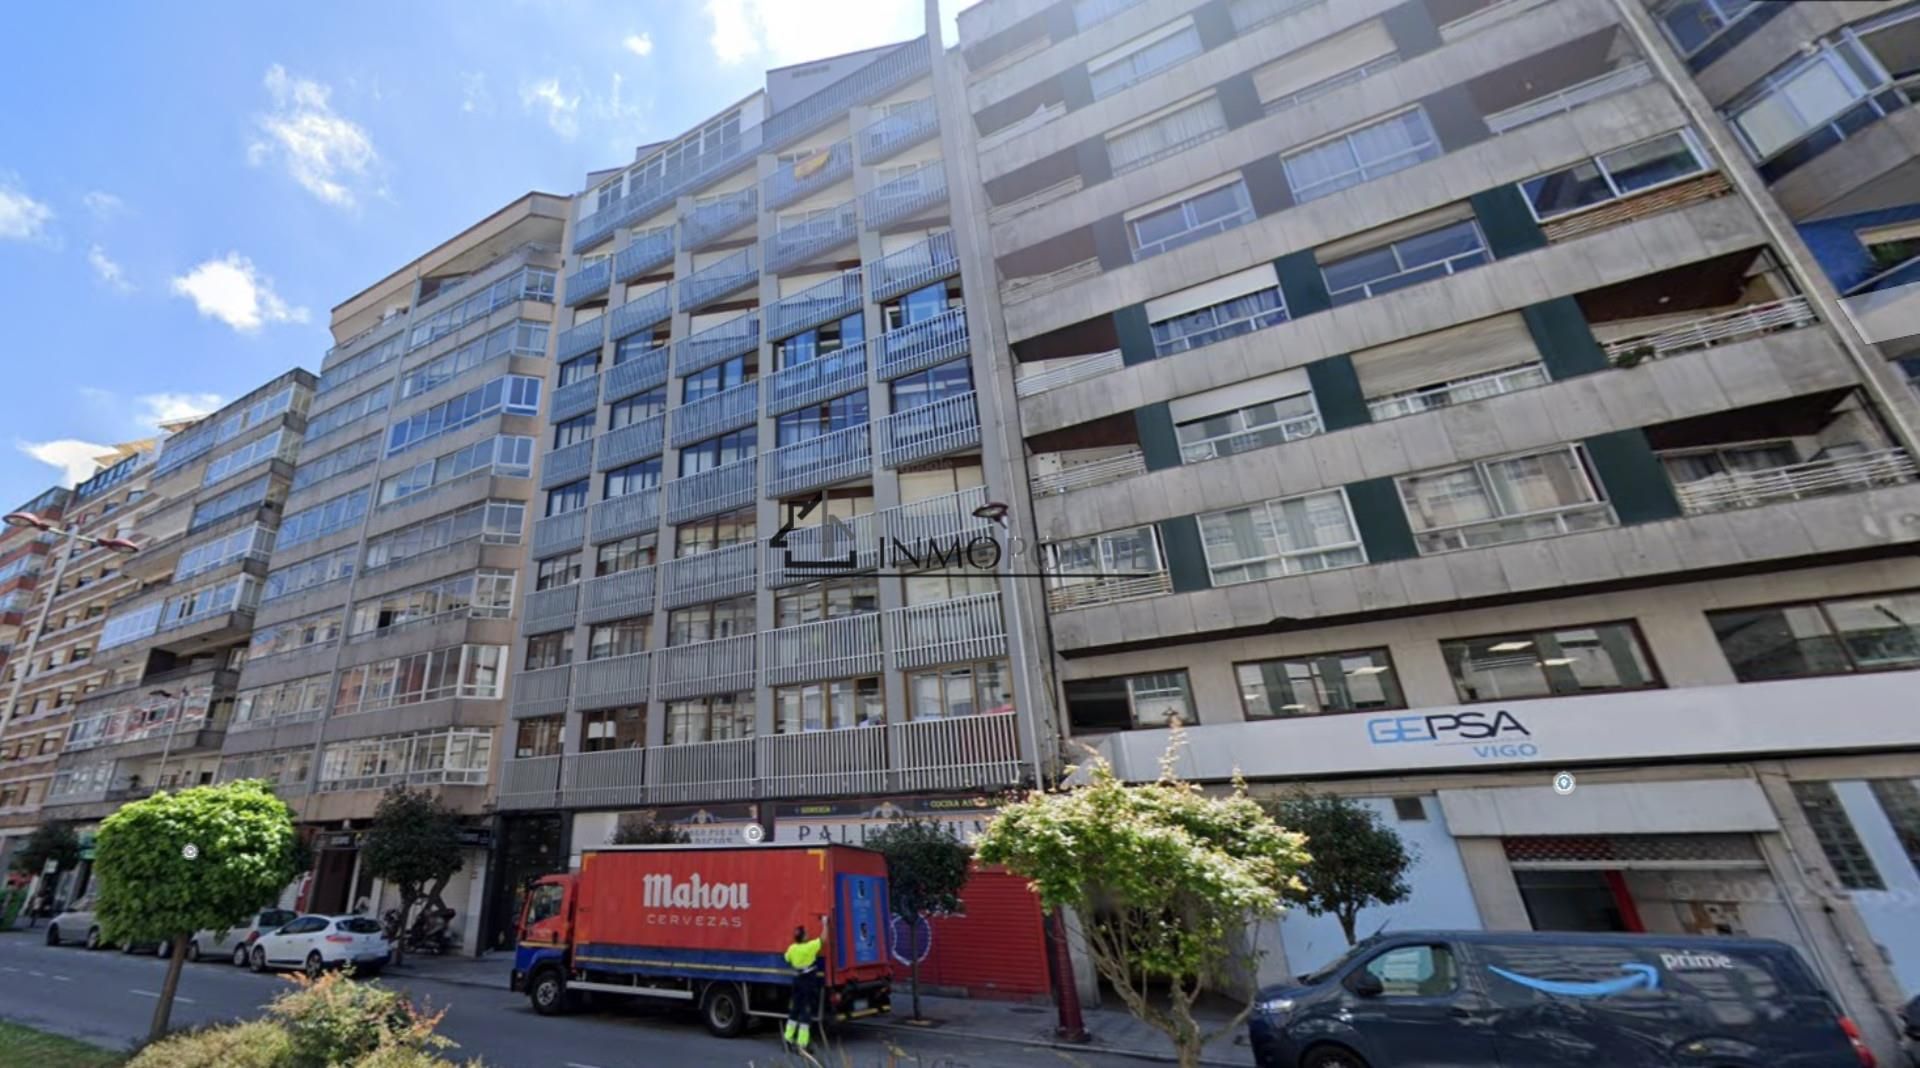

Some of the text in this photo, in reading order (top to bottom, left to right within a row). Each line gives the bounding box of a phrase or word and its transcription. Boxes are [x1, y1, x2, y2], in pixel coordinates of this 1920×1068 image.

[1368, 710, 1531, 744] GEPSA
[1474, 743, 1538, 758] VIGO
[642, 873, 752, 909] Mahou
[647, 914, 742, 927] CERVEZAS
[1660, 950, 1734, 971] prime
